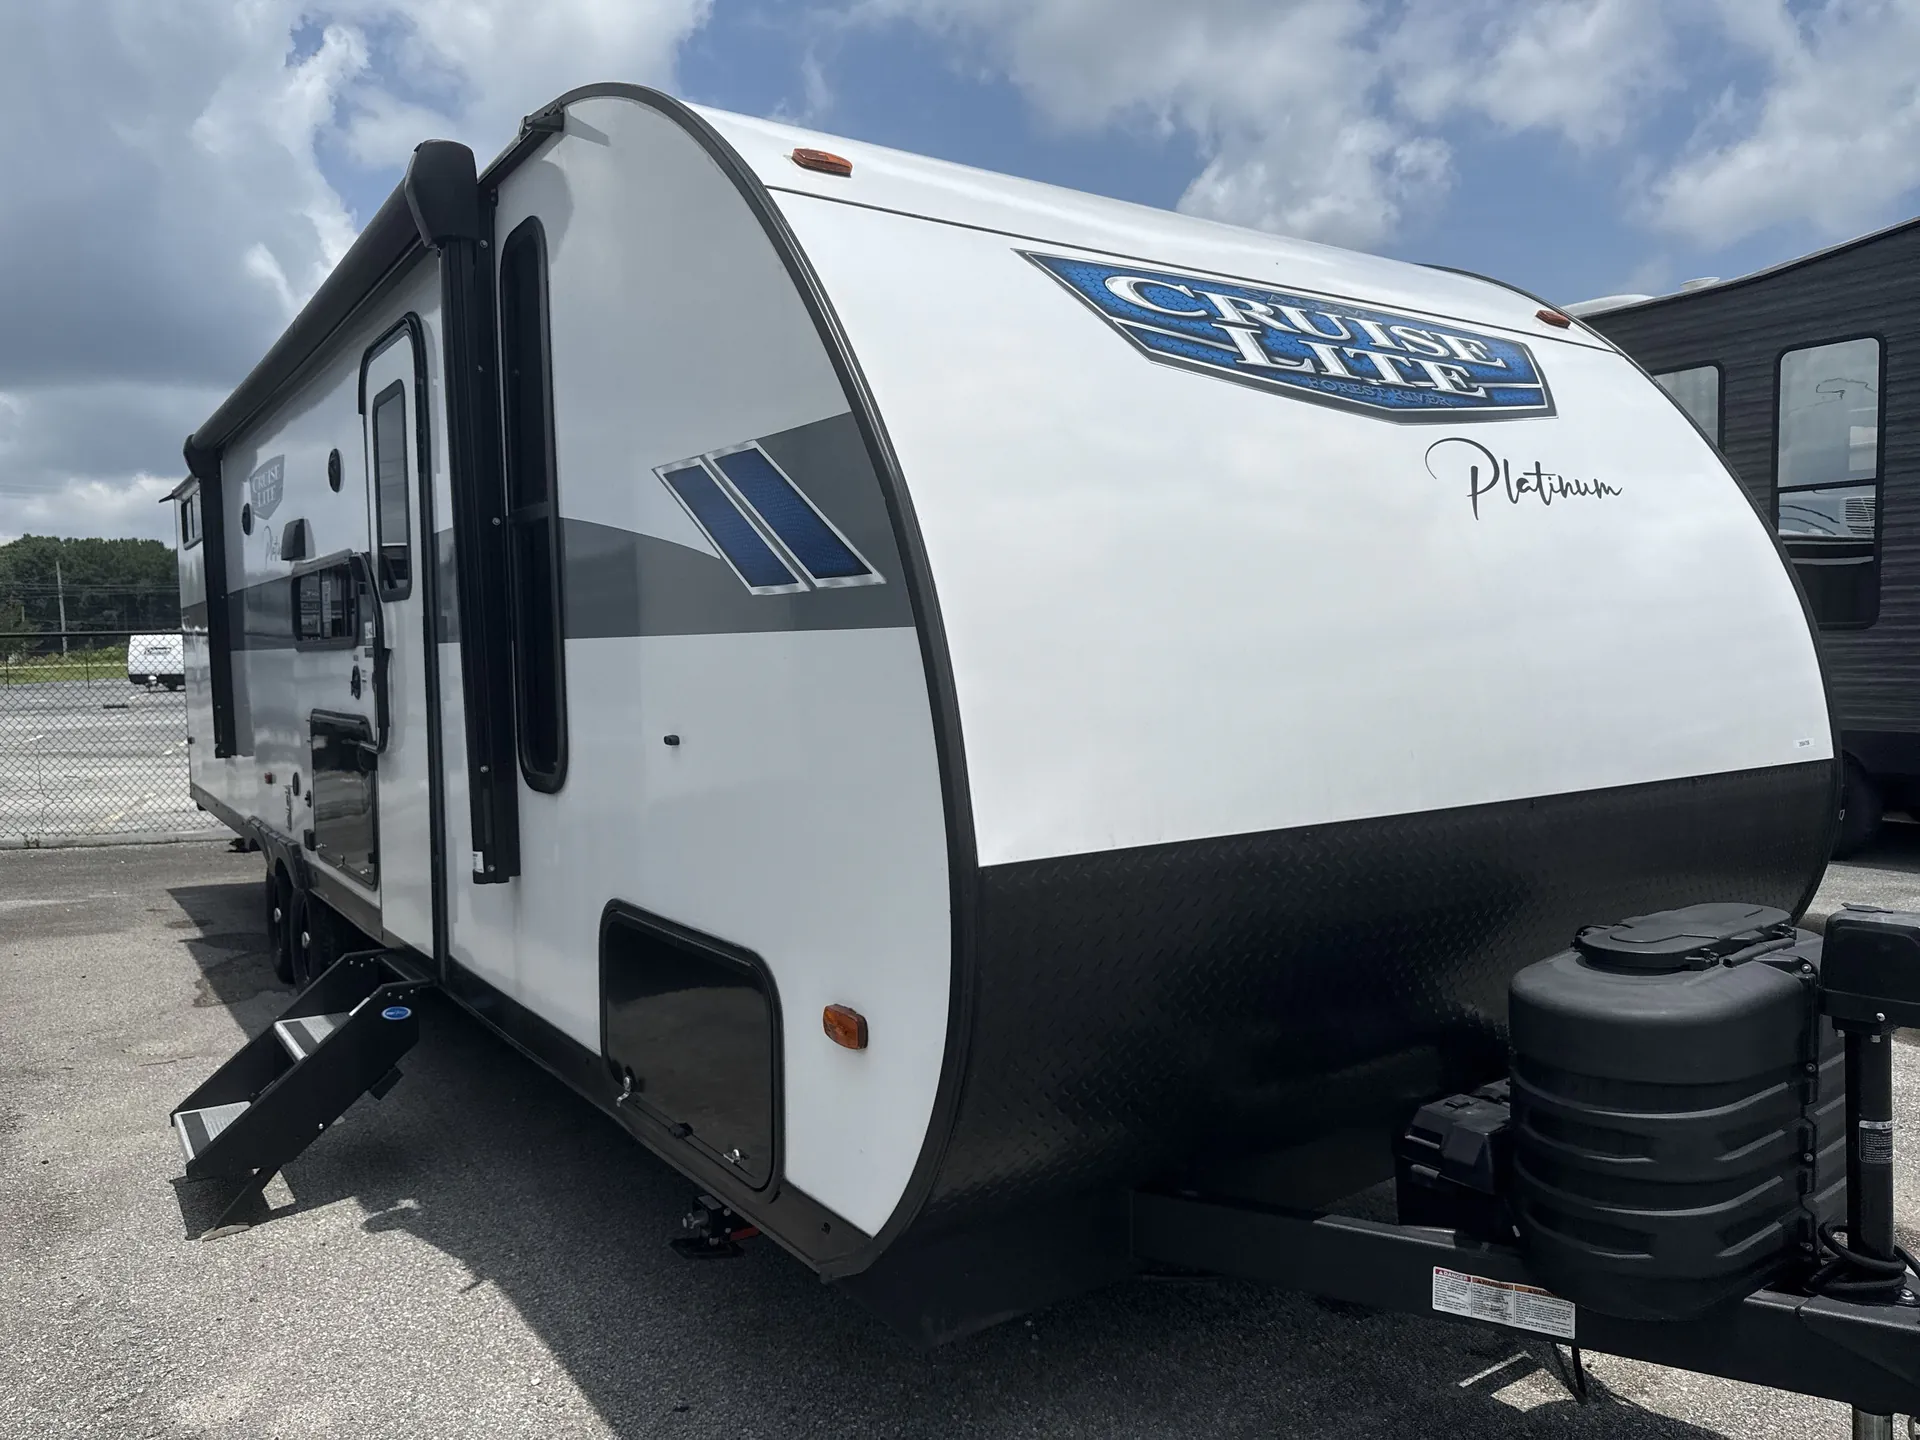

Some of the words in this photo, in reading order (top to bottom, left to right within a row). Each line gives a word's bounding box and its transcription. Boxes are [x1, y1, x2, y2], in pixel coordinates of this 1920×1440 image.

[1104, 275, 1505, 368] CRUISE
[1210, 323, 1487, 398] LITE
[1307, 377, 1389, 397] FOREST
[1393, 391, 1452, 407] RIVER
[1425, 437, 1623, 521] Platinum
